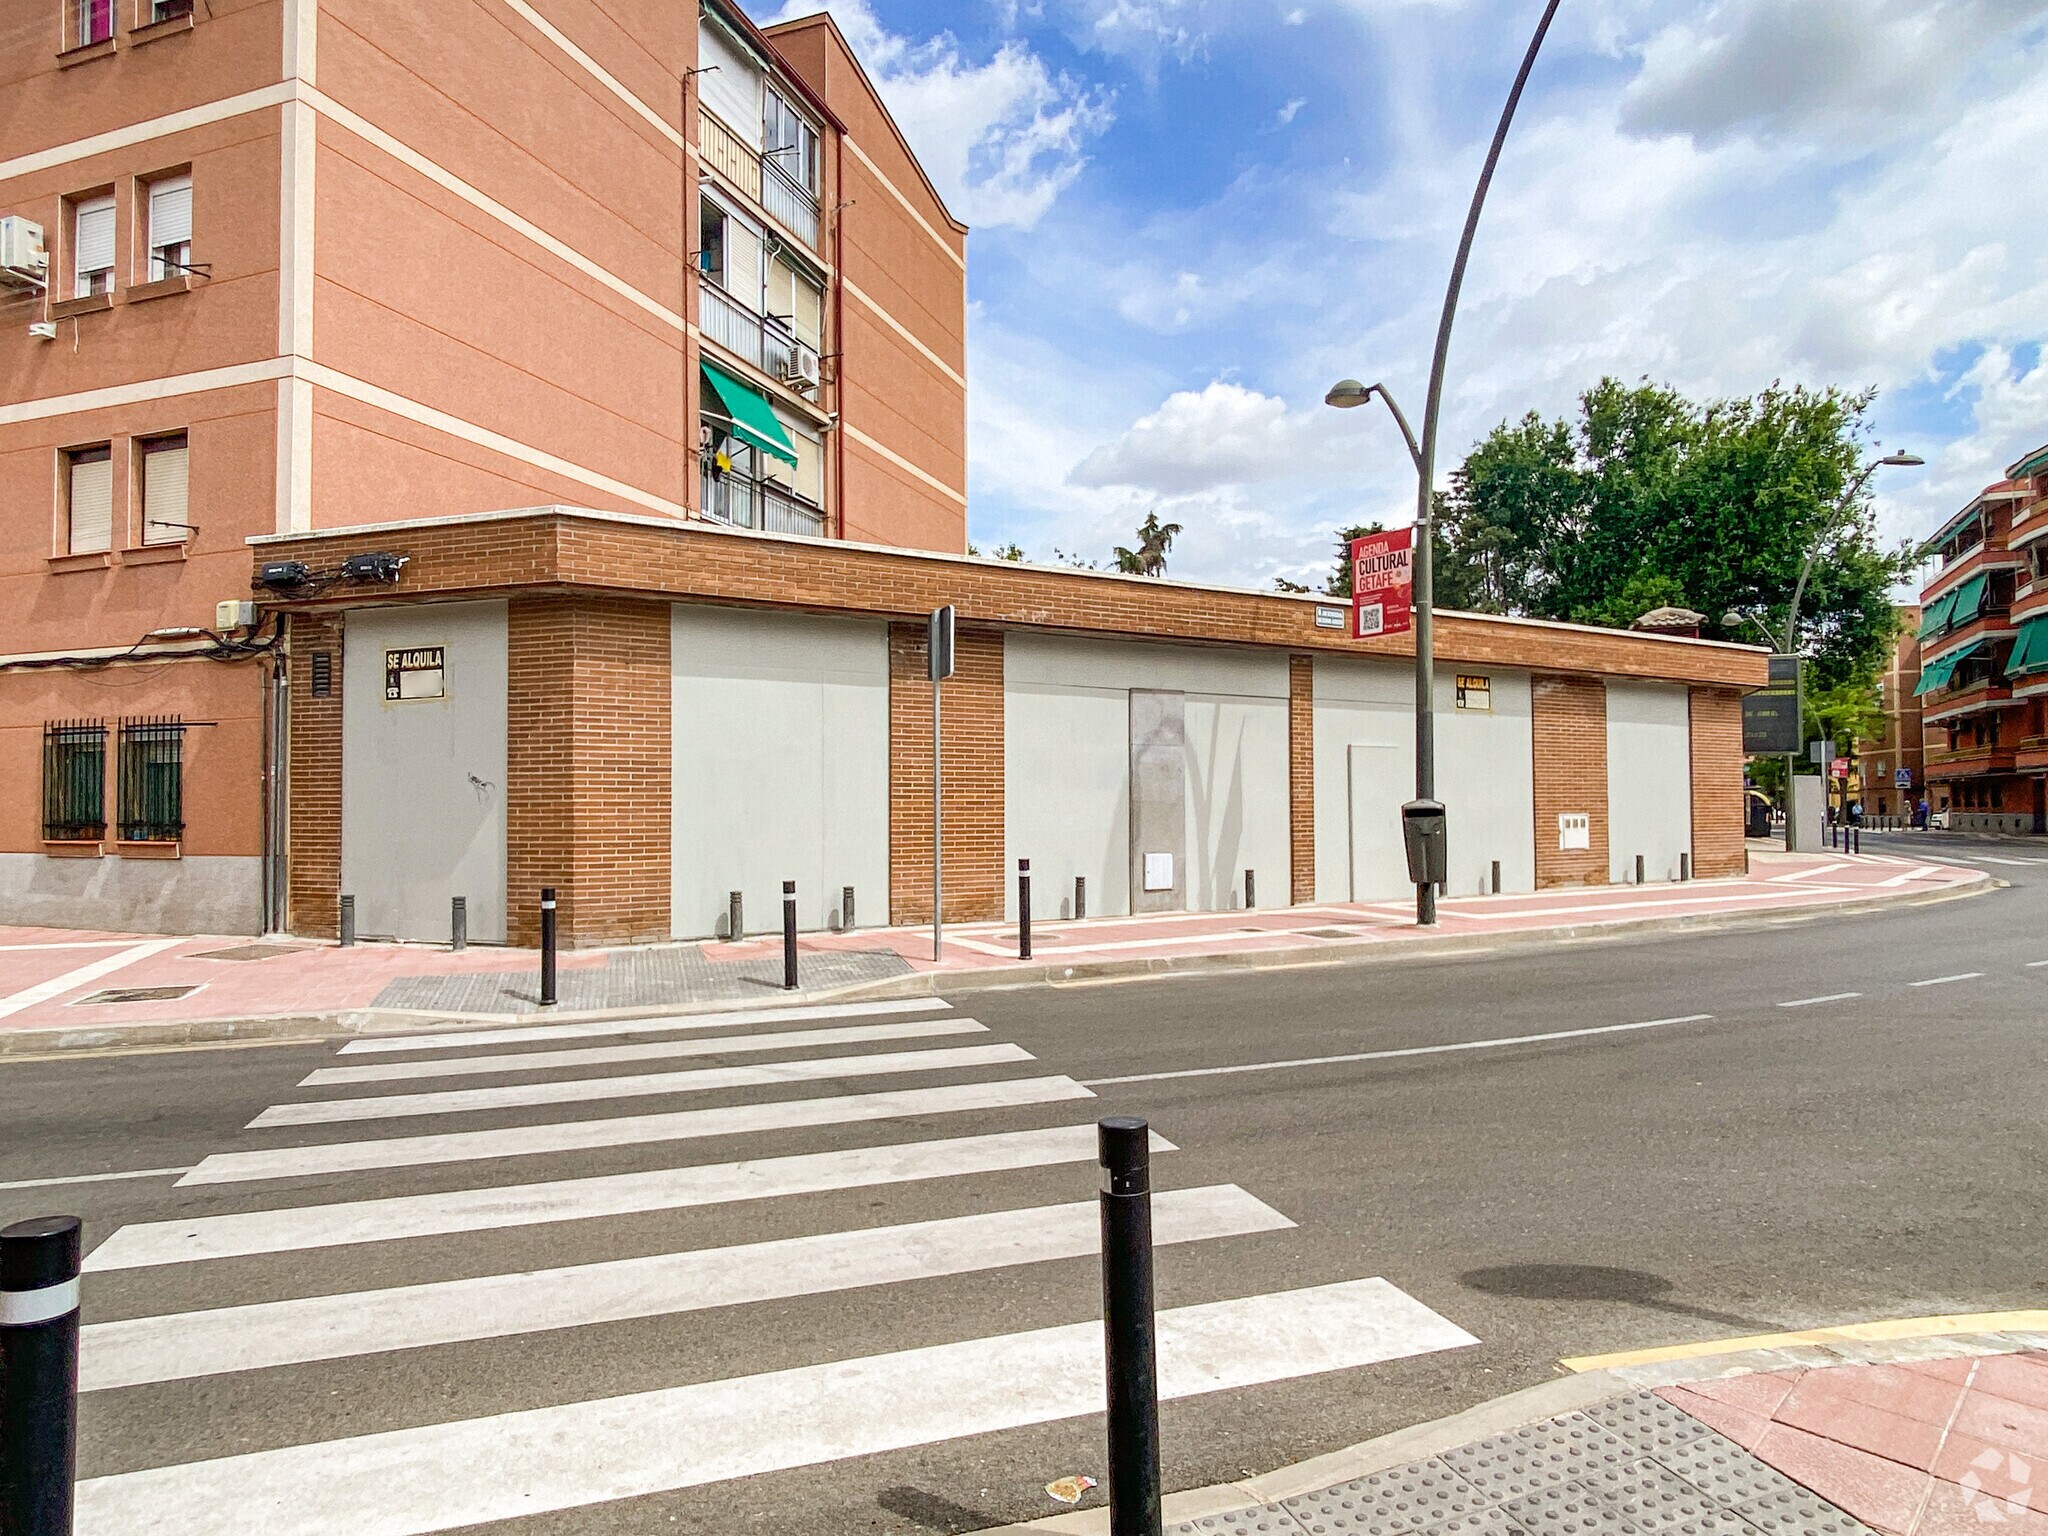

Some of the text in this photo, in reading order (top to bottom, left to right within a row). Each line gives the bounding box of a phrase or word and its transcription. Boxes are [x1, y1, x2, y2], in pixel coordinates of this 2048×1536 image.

[1358, 541, 1390, 559] AGENDA
[1359, 550, 1409, 576] CULTURAL
[1359, 570, 1394, 592] GETAFE
[387, 650, 442, 670] SE ALQUILA
